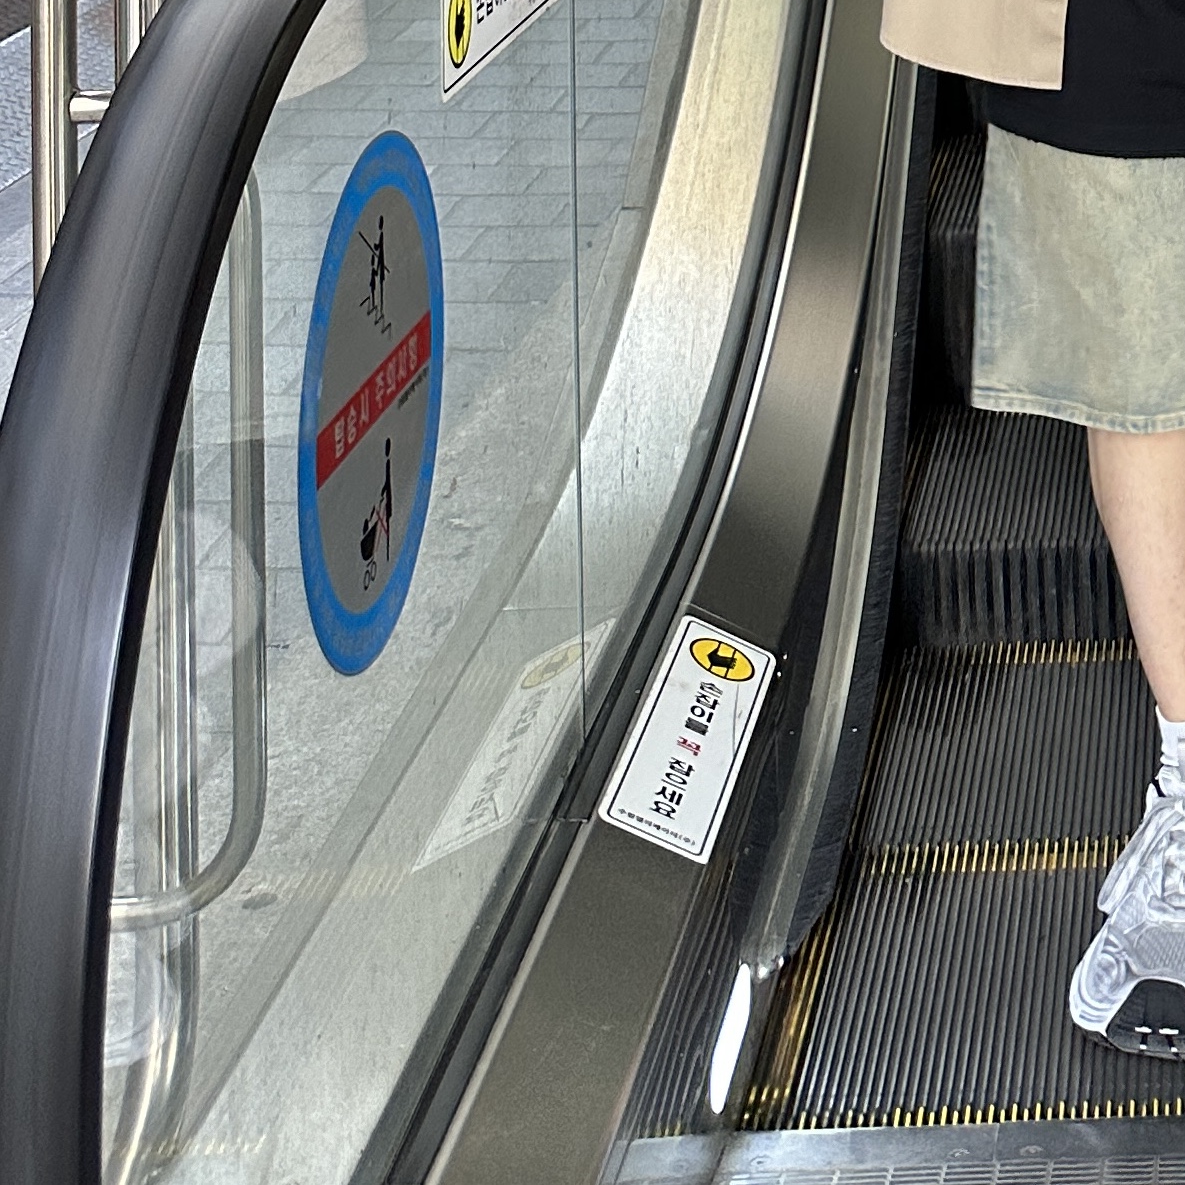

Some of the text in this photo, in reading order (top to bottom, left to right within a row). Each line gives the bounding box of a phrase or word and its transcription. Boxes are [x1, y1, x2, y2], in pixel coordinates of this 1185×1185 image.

[650, 680, 723, 821] 손잡이를 꼭 잡으세요
